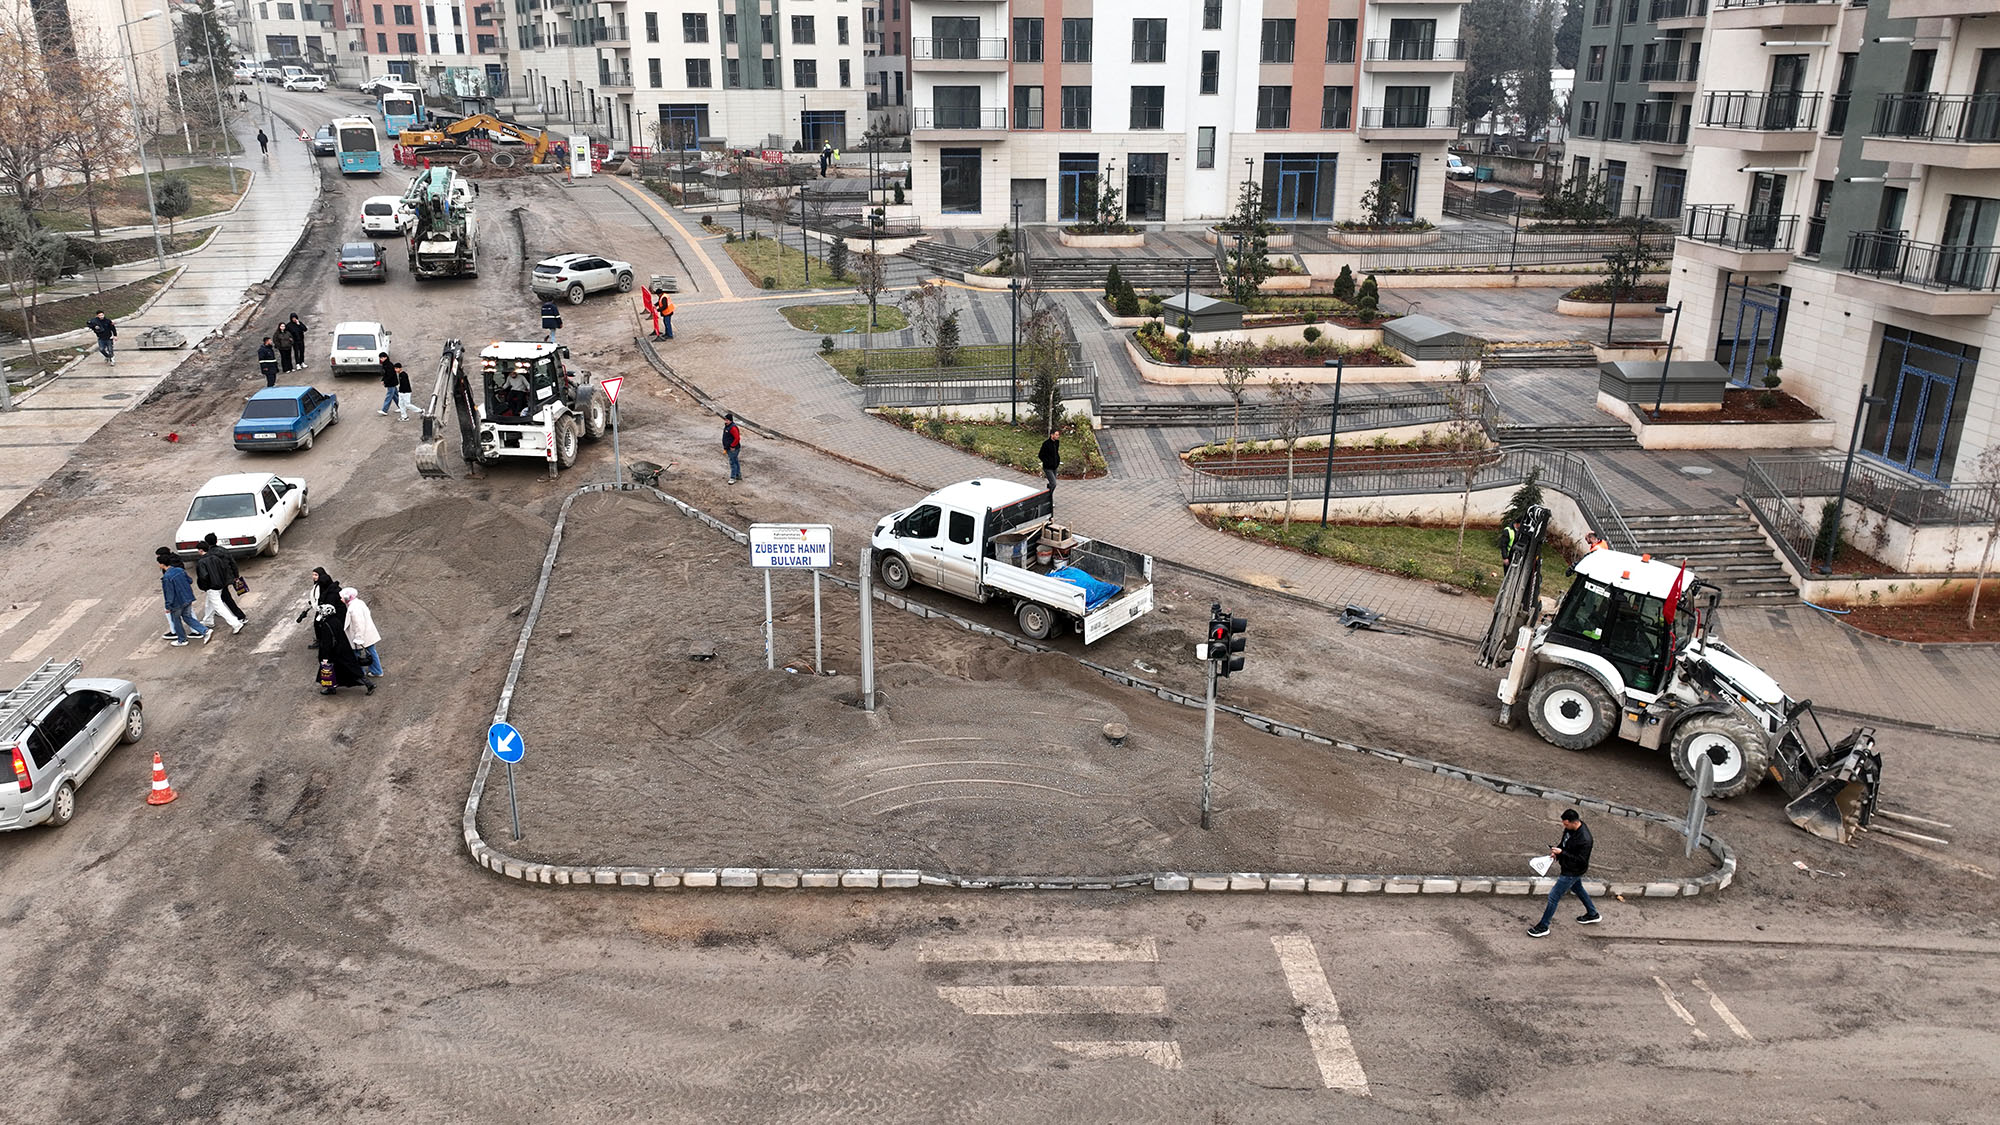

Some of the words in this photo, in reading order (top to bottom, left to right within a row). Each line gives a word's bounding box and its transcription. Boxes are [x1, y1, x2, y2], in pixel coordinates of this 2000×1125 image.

[755, 541, 795, 554] ZÜBEYDE
[797, 543, 826, 554] HANIM
[771, 556, 812, 566] BULVARI
